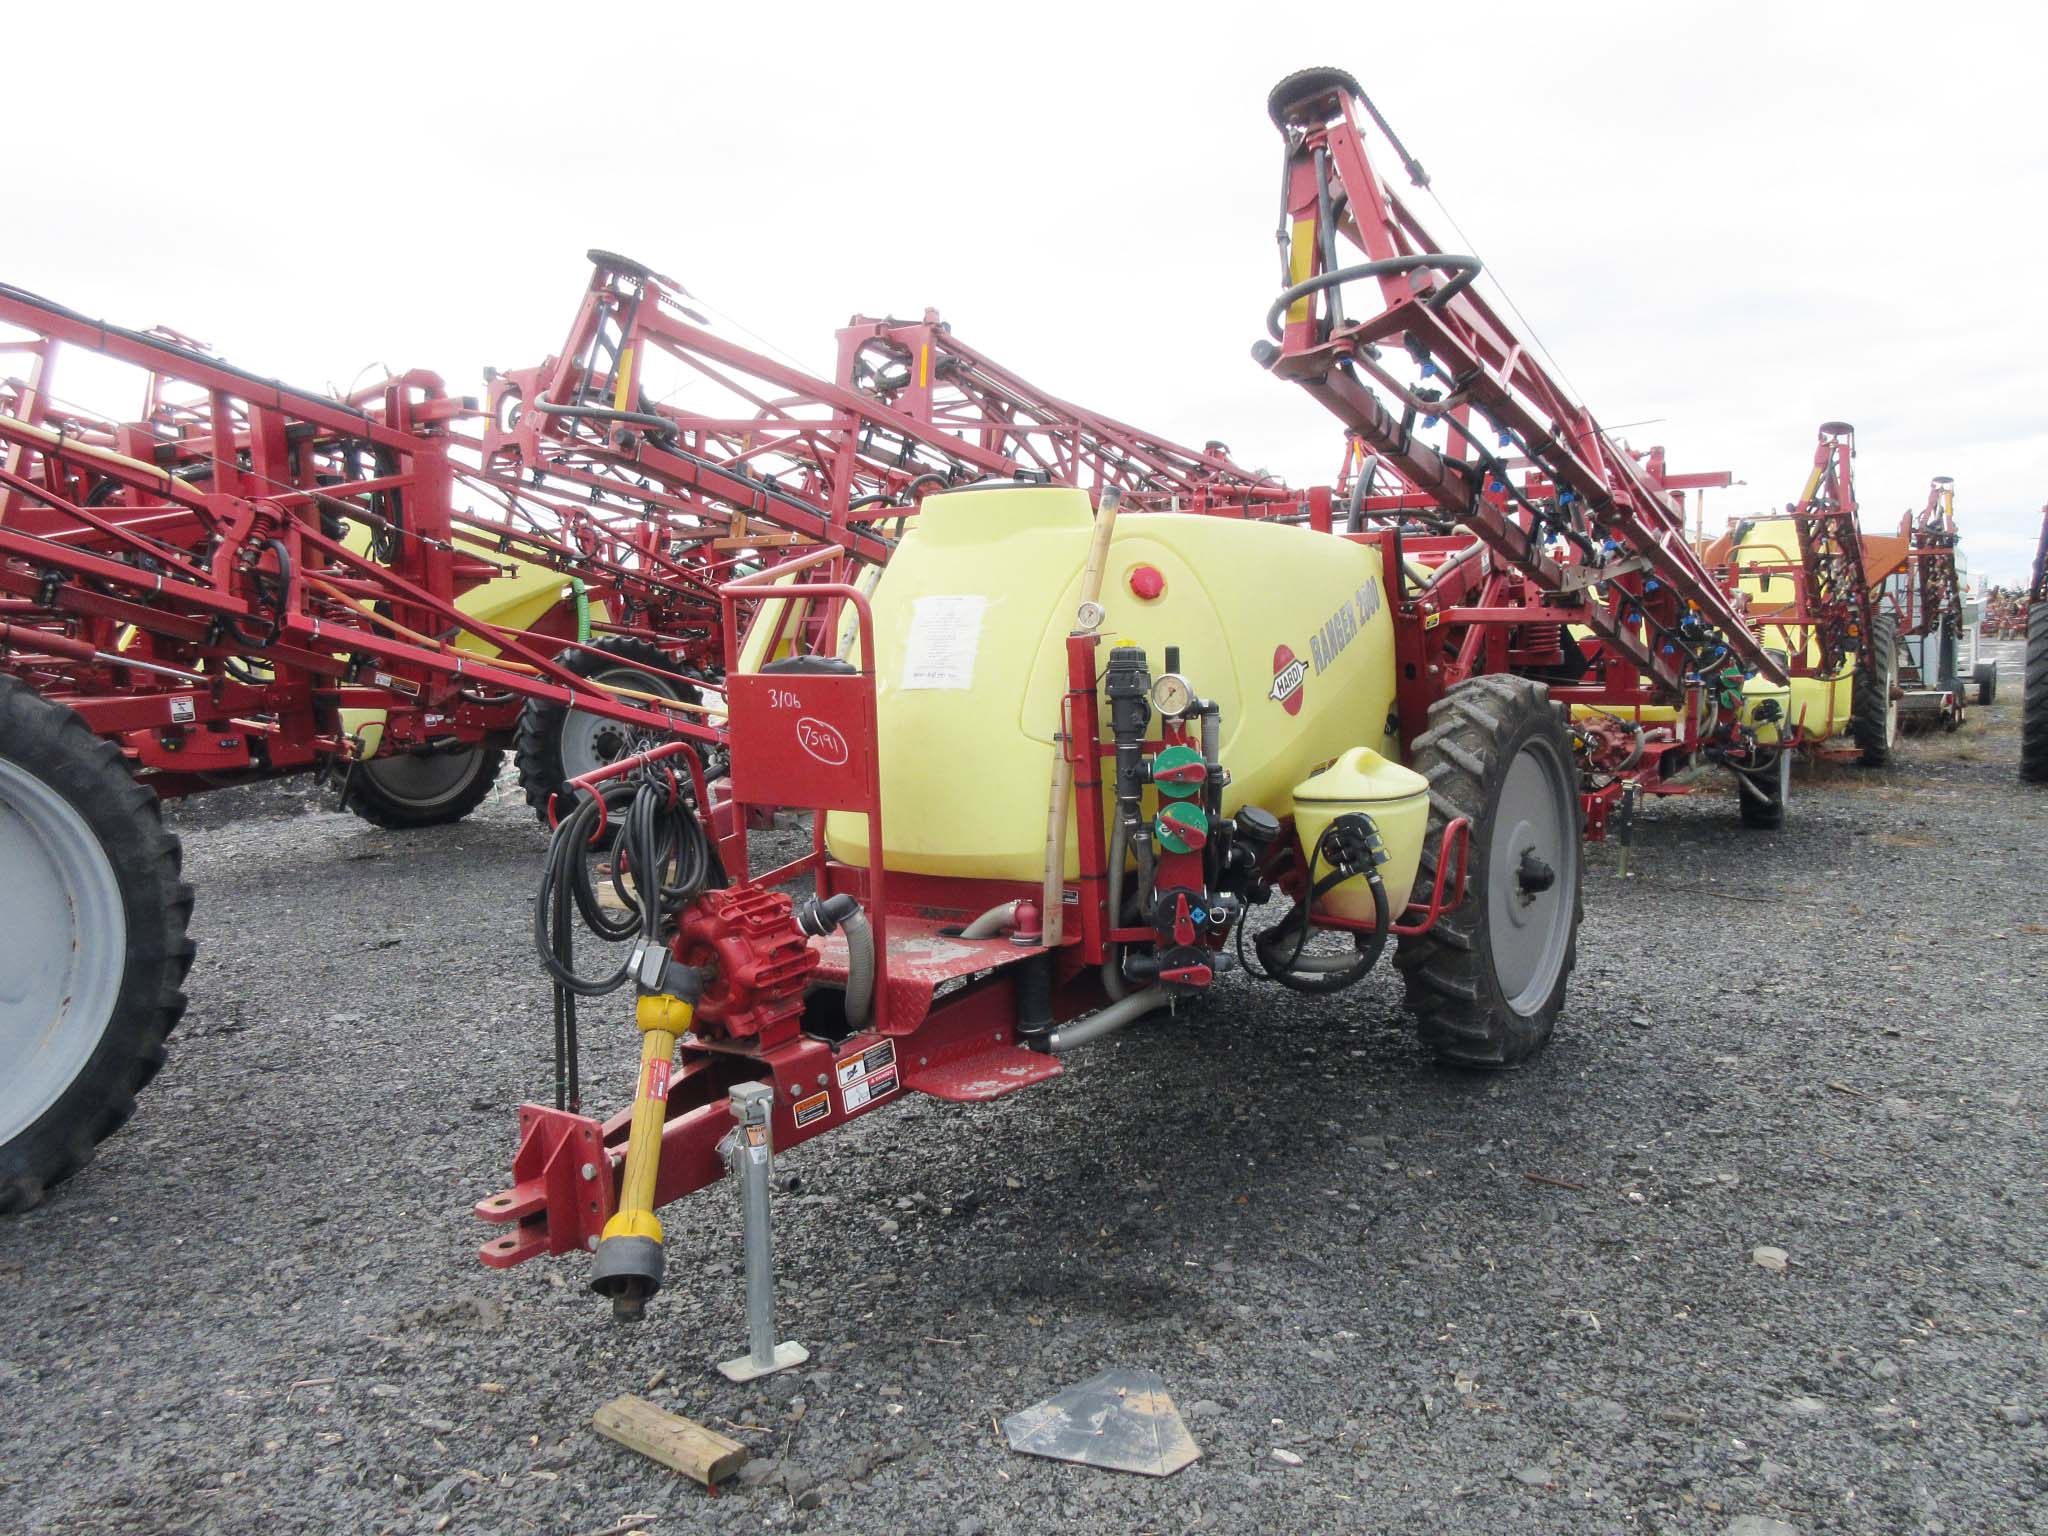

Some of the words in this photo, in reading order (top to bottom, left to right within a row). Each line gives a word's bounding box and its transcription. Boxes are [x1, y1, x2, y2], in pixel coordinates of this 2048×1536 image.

[1310, 600, 1358, 677] RANGER
[1276, 665, 1301, 695] HARDI
[768, 689, 801, 708] 3106
